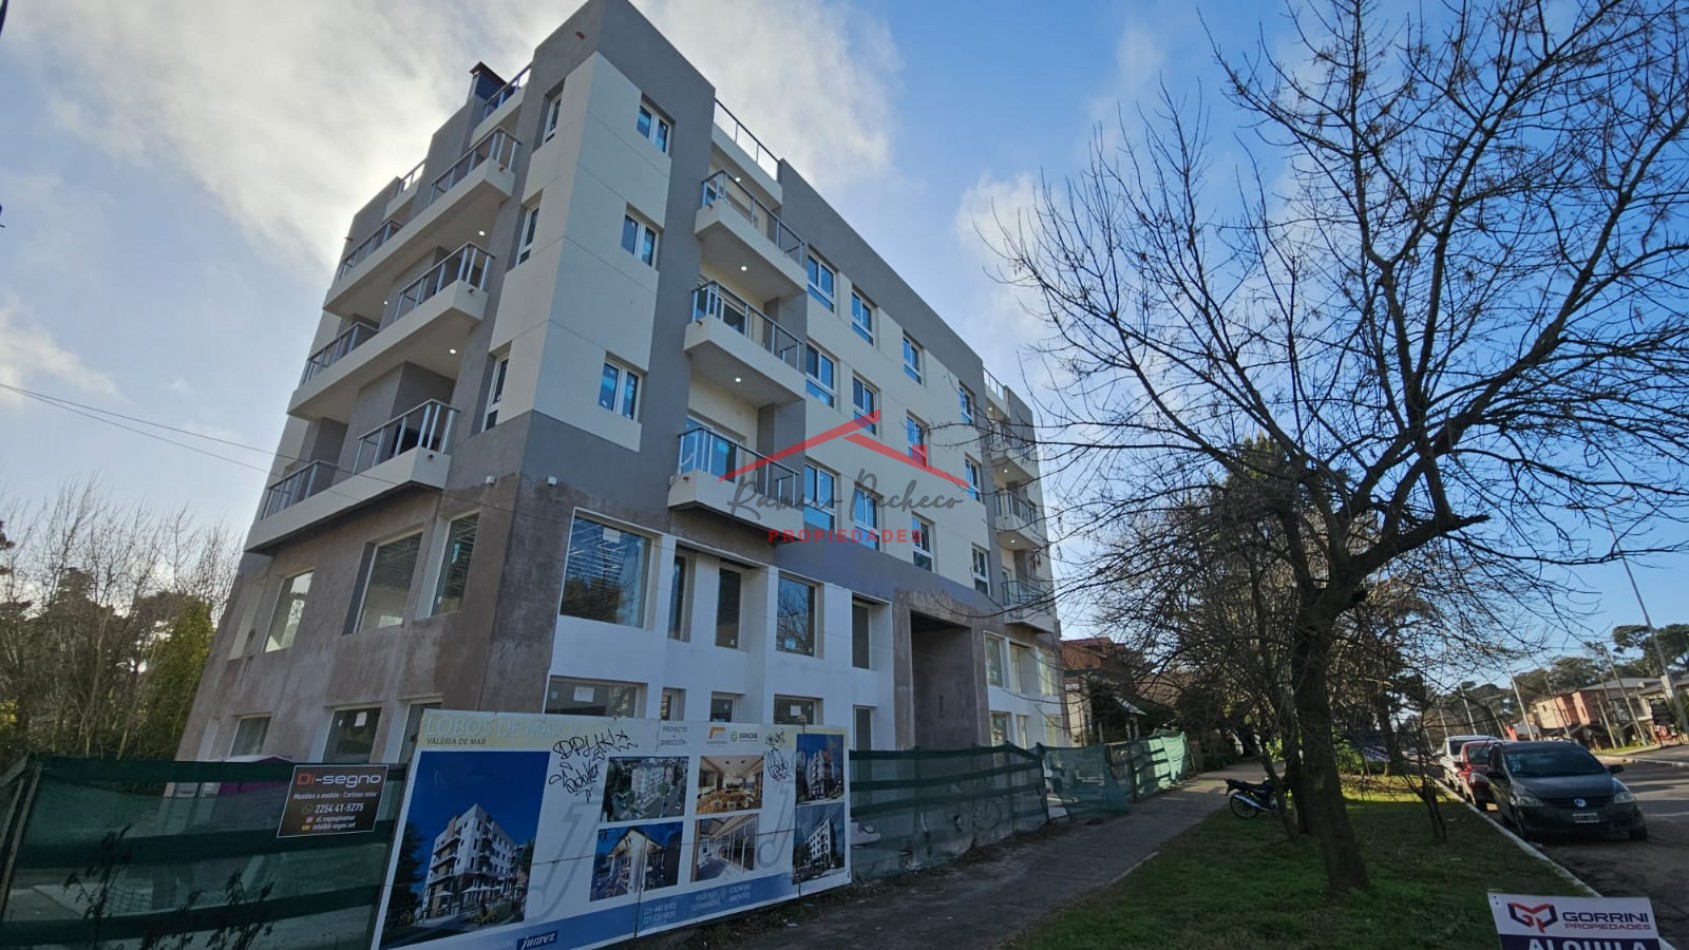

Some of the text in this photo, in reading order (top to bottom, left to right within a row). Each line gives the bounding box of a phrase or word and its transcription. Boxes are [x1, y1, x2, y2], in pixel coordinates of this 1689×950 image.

[425, 716, 491, 737] LOBOS
[496, 717, 520, 737] DE
[427, 737, 487, 745] VALERIA DE MAR
[296, 773, 381, 788] Di-segno
[1562, 911, 1649, 923] GORRINI
[1565, 923, 1651, 931] PROPIEDADES
